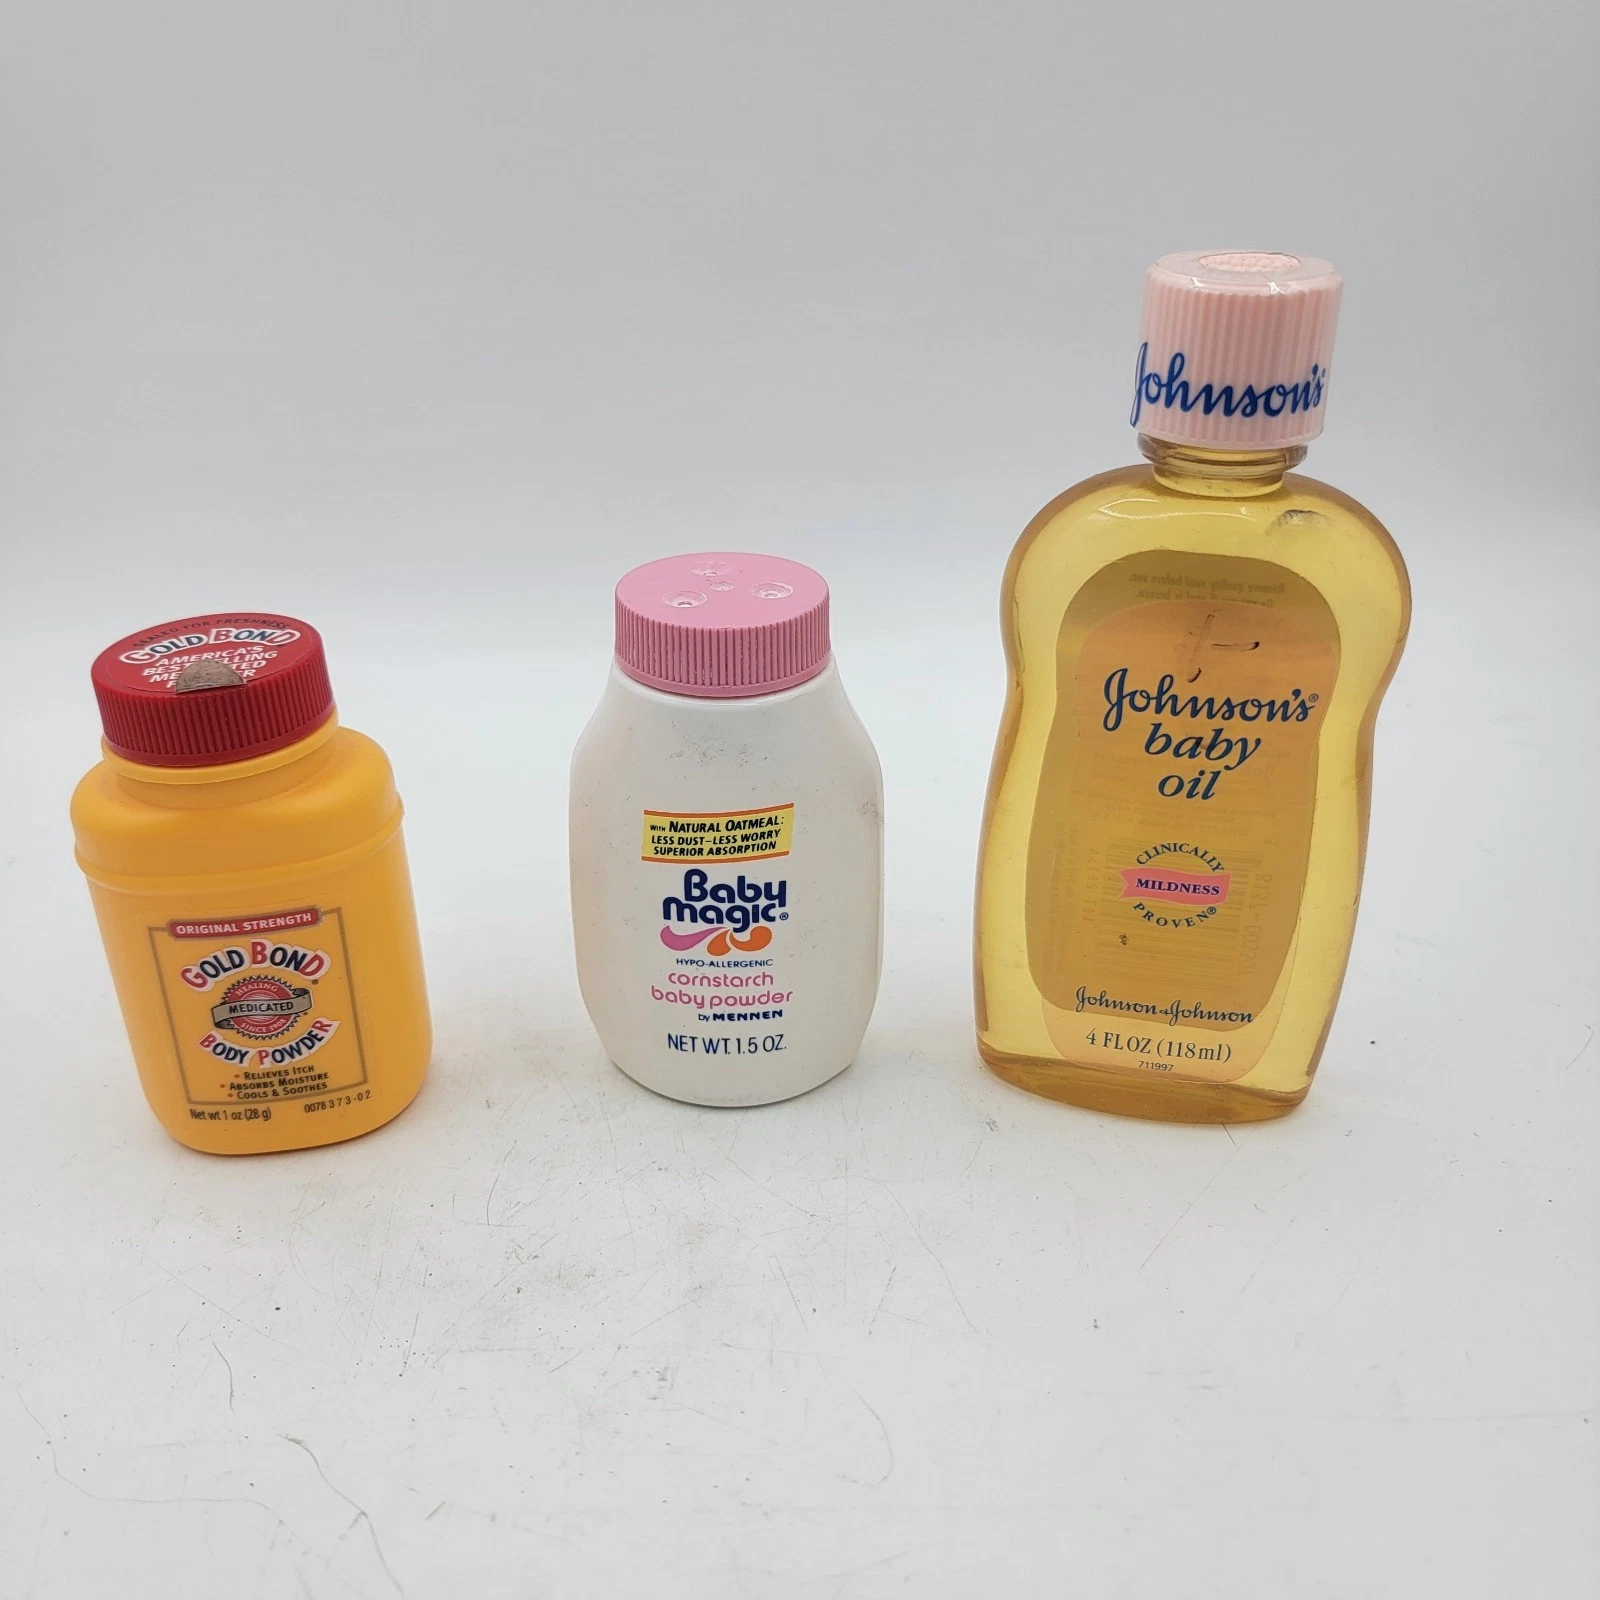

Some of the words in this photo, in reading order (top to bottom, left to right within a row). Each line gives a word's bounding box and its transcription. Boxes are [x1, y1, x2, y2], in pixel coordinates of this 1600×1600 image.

[1130, 342, 1326, 428] Johnson's
[133, 628, 180, 648] SEALED
[183, 621, 211, 630] FOR
[216, 618, 290, 630] FRESHNESS
[120, 635, 206, 663] GOLD
[210, 628, 300, 645] BOND
[155, 645, 265, 666] AMERICA'S
[1144, 722, 1261, 771] baby
[1158, 770, 1222, 800] oil
[669, 821, 722, 833] NATURAL
[725, 815, 785, 832] OATMEAL:
[651, 835, 675, 846] LESS
[740, 829, 781, 843] WORRY
[653, 846, 704, 857] SUPERIOR
[706, 841, 777, 857] ABSORPTION
[1136, 842, 1225, 873] CLINICALLY
[684, 868, 787, 908] Baby
[1135, 878, 1220, 896] MILDNESS
[176, 923, 239, 936] ORIGINAL
[243, 912, 312, 931] STRENGTH
[180, 948, 246, 990] GOLD
[676, 958, 774, 968] HYPO-ALLERGENIC
[236, 983, 279, 996] HEALING
[668, 972, 774, 987] cornstarch
[651, 985, 705, 1009] baby
[709, 990, 793, 1009] powder
[1075, 985, 1157, 1012] Johnson
[1168, 1000, 1254, 1026] Johnson
[229, 1002, 294, 1014] MEDICATED
[698, 1013, 710, 1022] by
[713, 1010, 783, 1021] MENNEN
[240, 1022, 267, 1033] SINCE
[199, 1033, 250, 1065] BODY
[258, 1020, 334, 1066] POWDER
[668, 1033, 698, 1053] NET
[702, 1036, 731, 1055] WT.
[735, 1037, 758, 1054] 1.5
[762, 1034, 787, 1053] OZ.
[1085, 1028, 1096, 1045] 4
[1103, 1031, 1123, 1050] FL
[1127, 1036, 1151, 1054] OZ
[1156, 1038, 1231, 1064] (118ml)
[244, 1069, 290, 1080] RELIEVES
[293, 1065, 315, 1075] ITCH
[1138, 1061, 1174, 1072] 711997
[229, 1081, 275, 1091] ABSORBS
[278, 1072, 329, 1086] MOISTURE
[237, 1091, 269, 1100] COOLS
[272, 1089, 280, 1097] &
[283, 1082, 328, 1096] SOOTHES
[189, 1108, 206, 1120] Net
[209, 1110, 222, 1121] wt
[223, 1108, 228, 1120] 1
[231, 1111, 243, 1121] oz
[244, 1108, 260, 1122] (28
[262, 1107, 272, 1122] g)
